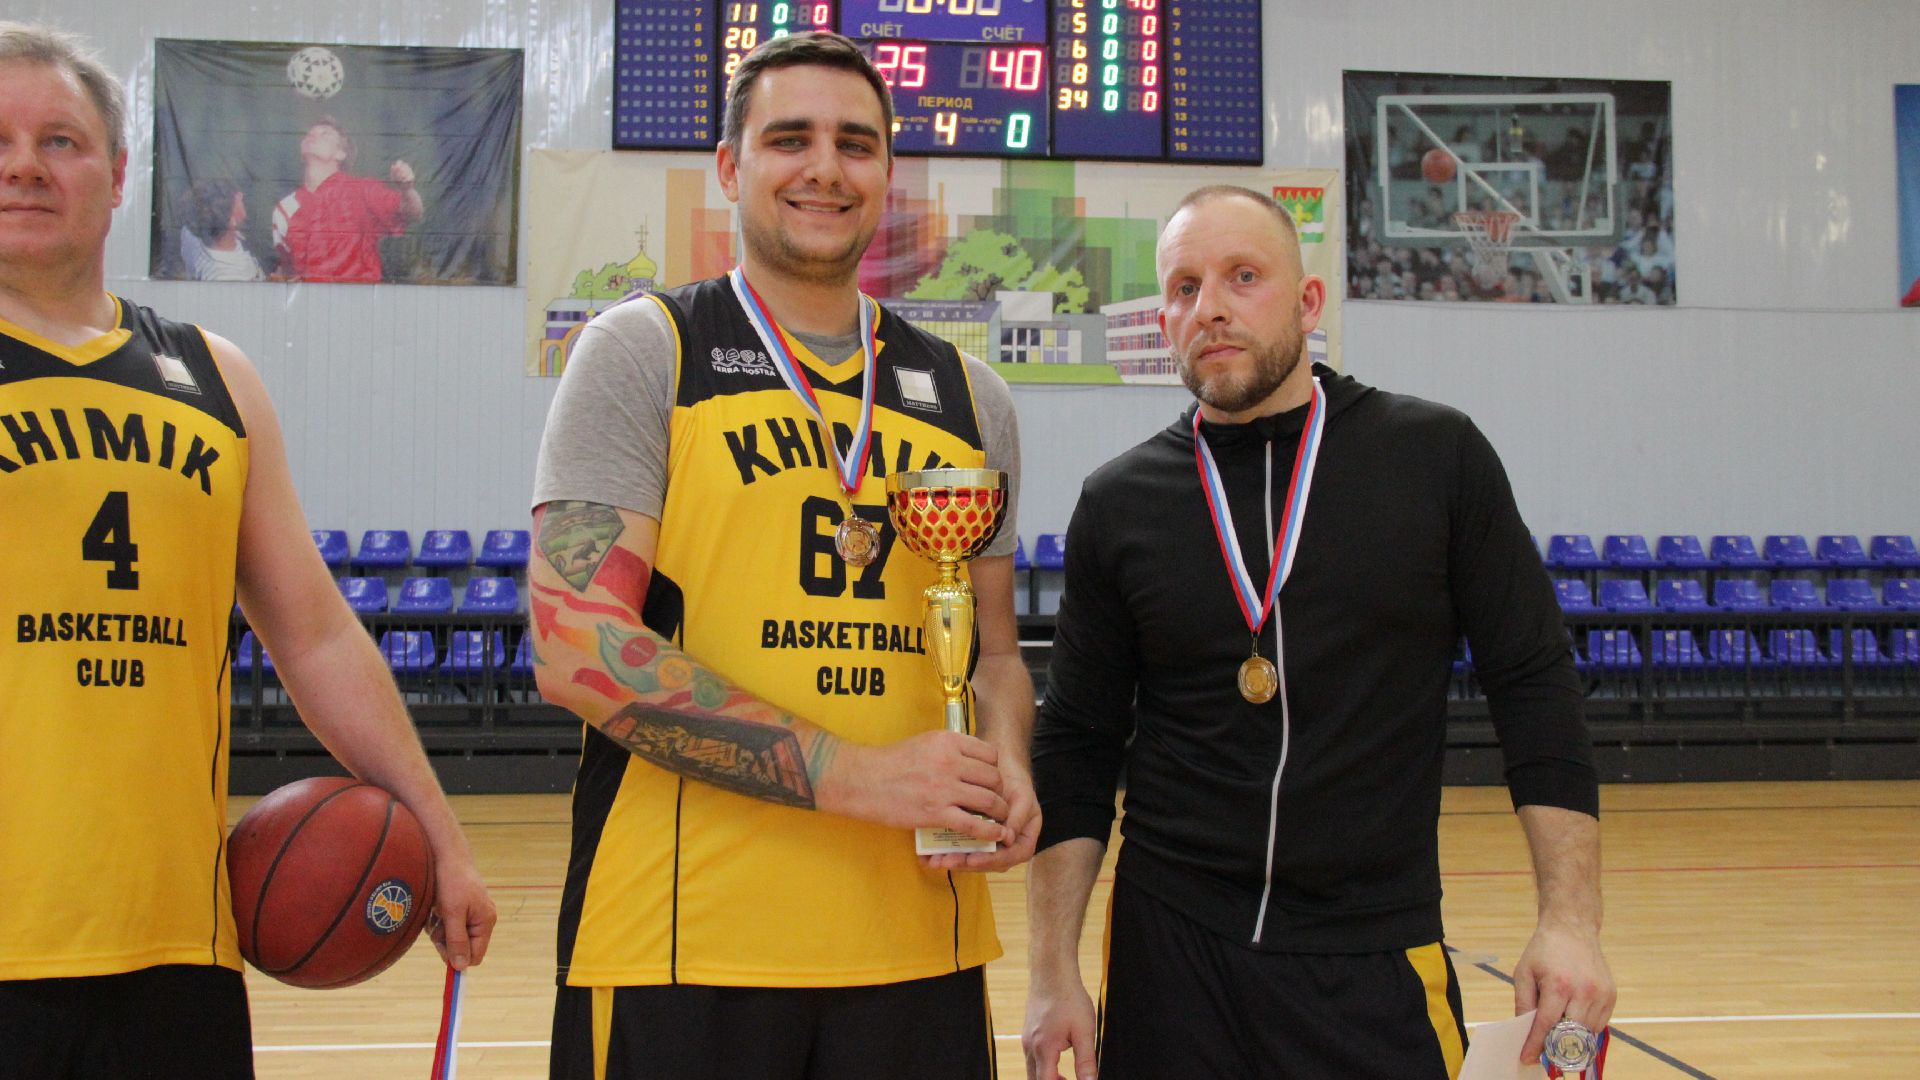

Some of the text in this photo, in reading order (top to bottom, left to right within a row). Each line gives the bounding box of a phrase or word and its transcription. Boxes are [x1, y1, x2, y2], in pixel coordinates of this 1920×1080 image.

[694, 8, 702, 17] 7
[732, 3, 828, 24] 11 0 0
[861, 21, 903, 37] СЧЁТ
[1072, 12, 1157, 35] 5 0 0
[1172, 22, 1181, 31] 7
[725, 27, 757, 48] 20
[982, 25, 1024, 41] СЧЁТ
[694, 54, 708, 62] 10
[1072, 39, 1157, 61] 6 0 0
[694, 69, 708, 78] 11
[875, 46, 926, 87] 25
[989, 49, 1041, 90] 40
[1072, 63, 1157, 86] 8 0 0
[1174, 67, 1187, 76] 10
[694, 84, 708, 93] 12
[1174, 83, 1187, 91] 11
[694, 100, 708, 109] 13
[918, 97, 973, 110] ПЕРИОД
[1057, 88, 1157, 112] 34 0 0
[1174, 97, 1188, 107] 12
[694, 115, 708, 124] 14
[1174, 113, 1188, 122] 13
[694, 131, 708, 140] 15
[935, 112, 957, 145] 4
[1007, 114, 1030, 148] 0
[1174, 128, 1188, 137] 14
[1174, 142, 1188, 151] 15
[712, 365, 776, 377] TERRA NOSTRA
[82, 491, 139, 590] 4
[799, 495, 898, 600] 67
[17, 612, 187, 647] BASKETBALL
[761, 619, 926, 656] BASKETBALL
[77, 658, 145, 688] CLUB
[816, 666, 885, 697] CLUB
